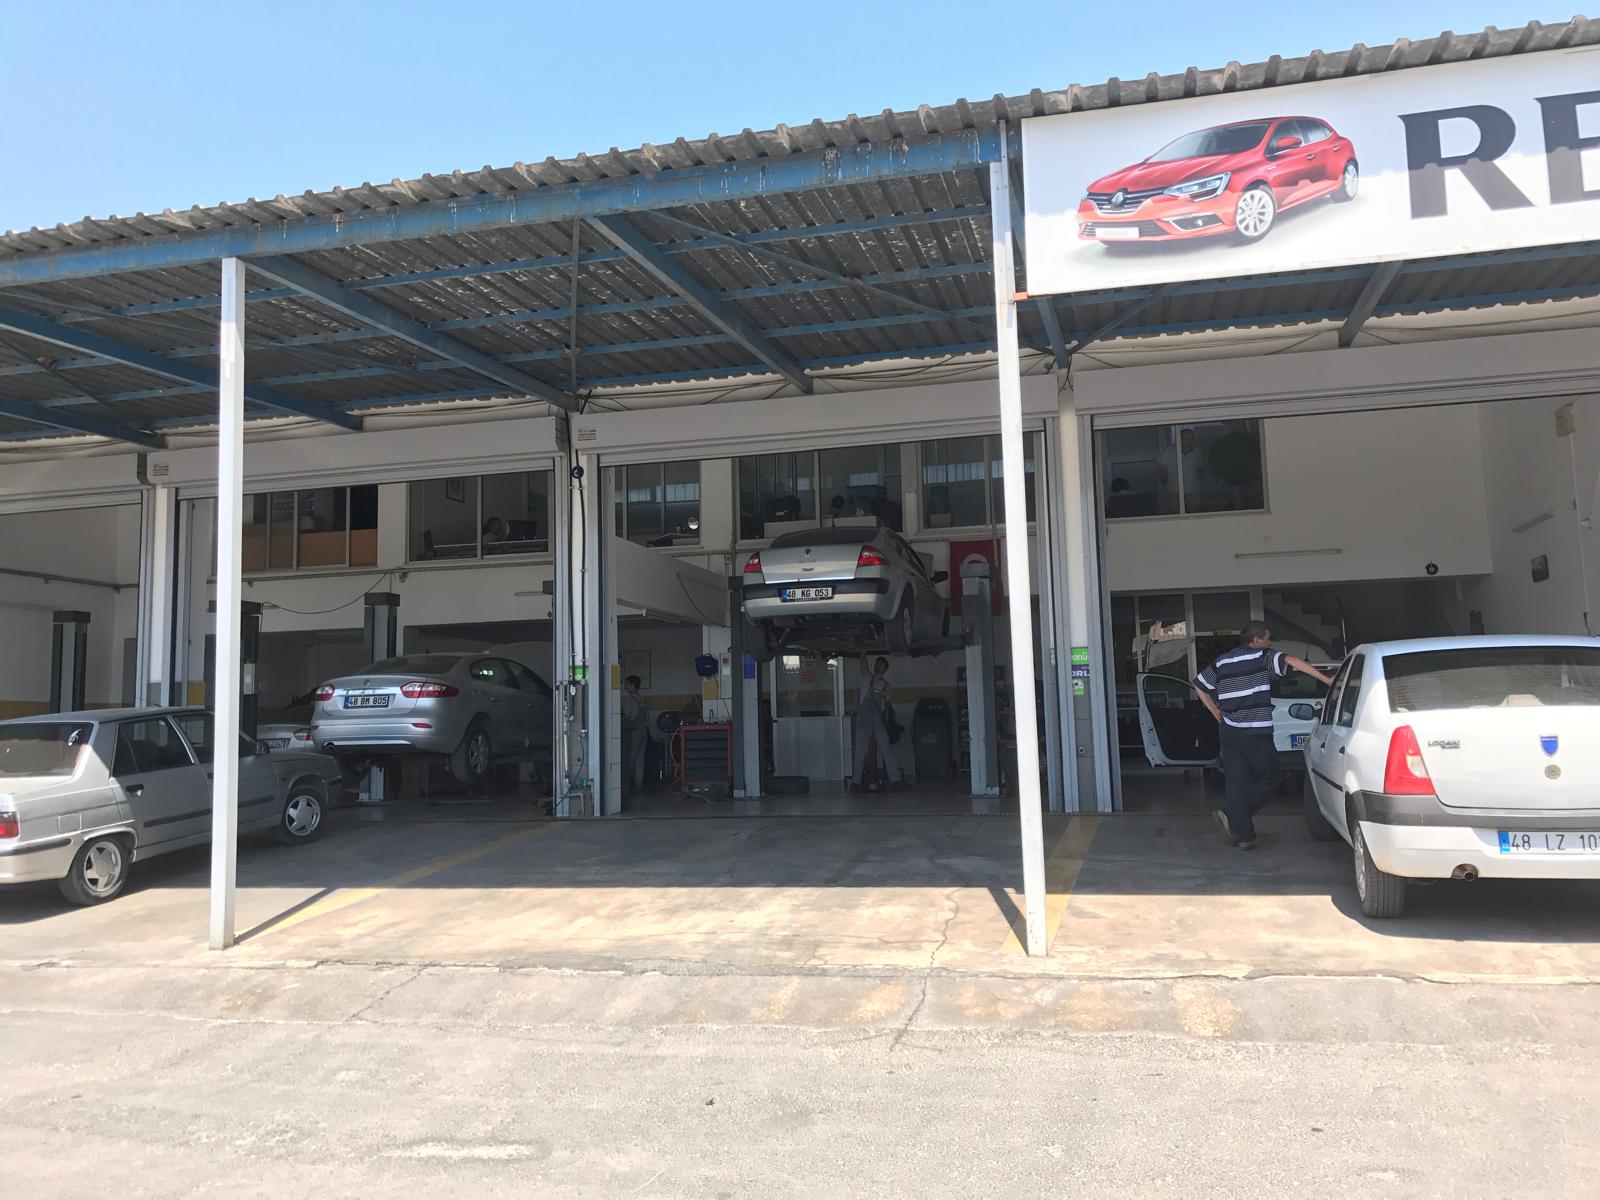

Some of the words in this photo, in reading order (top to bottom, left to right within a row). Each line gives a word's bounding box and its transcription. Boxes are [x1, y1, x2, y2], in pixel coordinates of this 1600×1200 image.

[786, 590, 796, 598] 48
[801, 589, 811, 598] KG
[814, 588, 829, 597] 053
[1511, 834, 1531, 851] 48
[1545, 833, 1566, 851] LZ
[1579, 834, 1600, 851] 10
